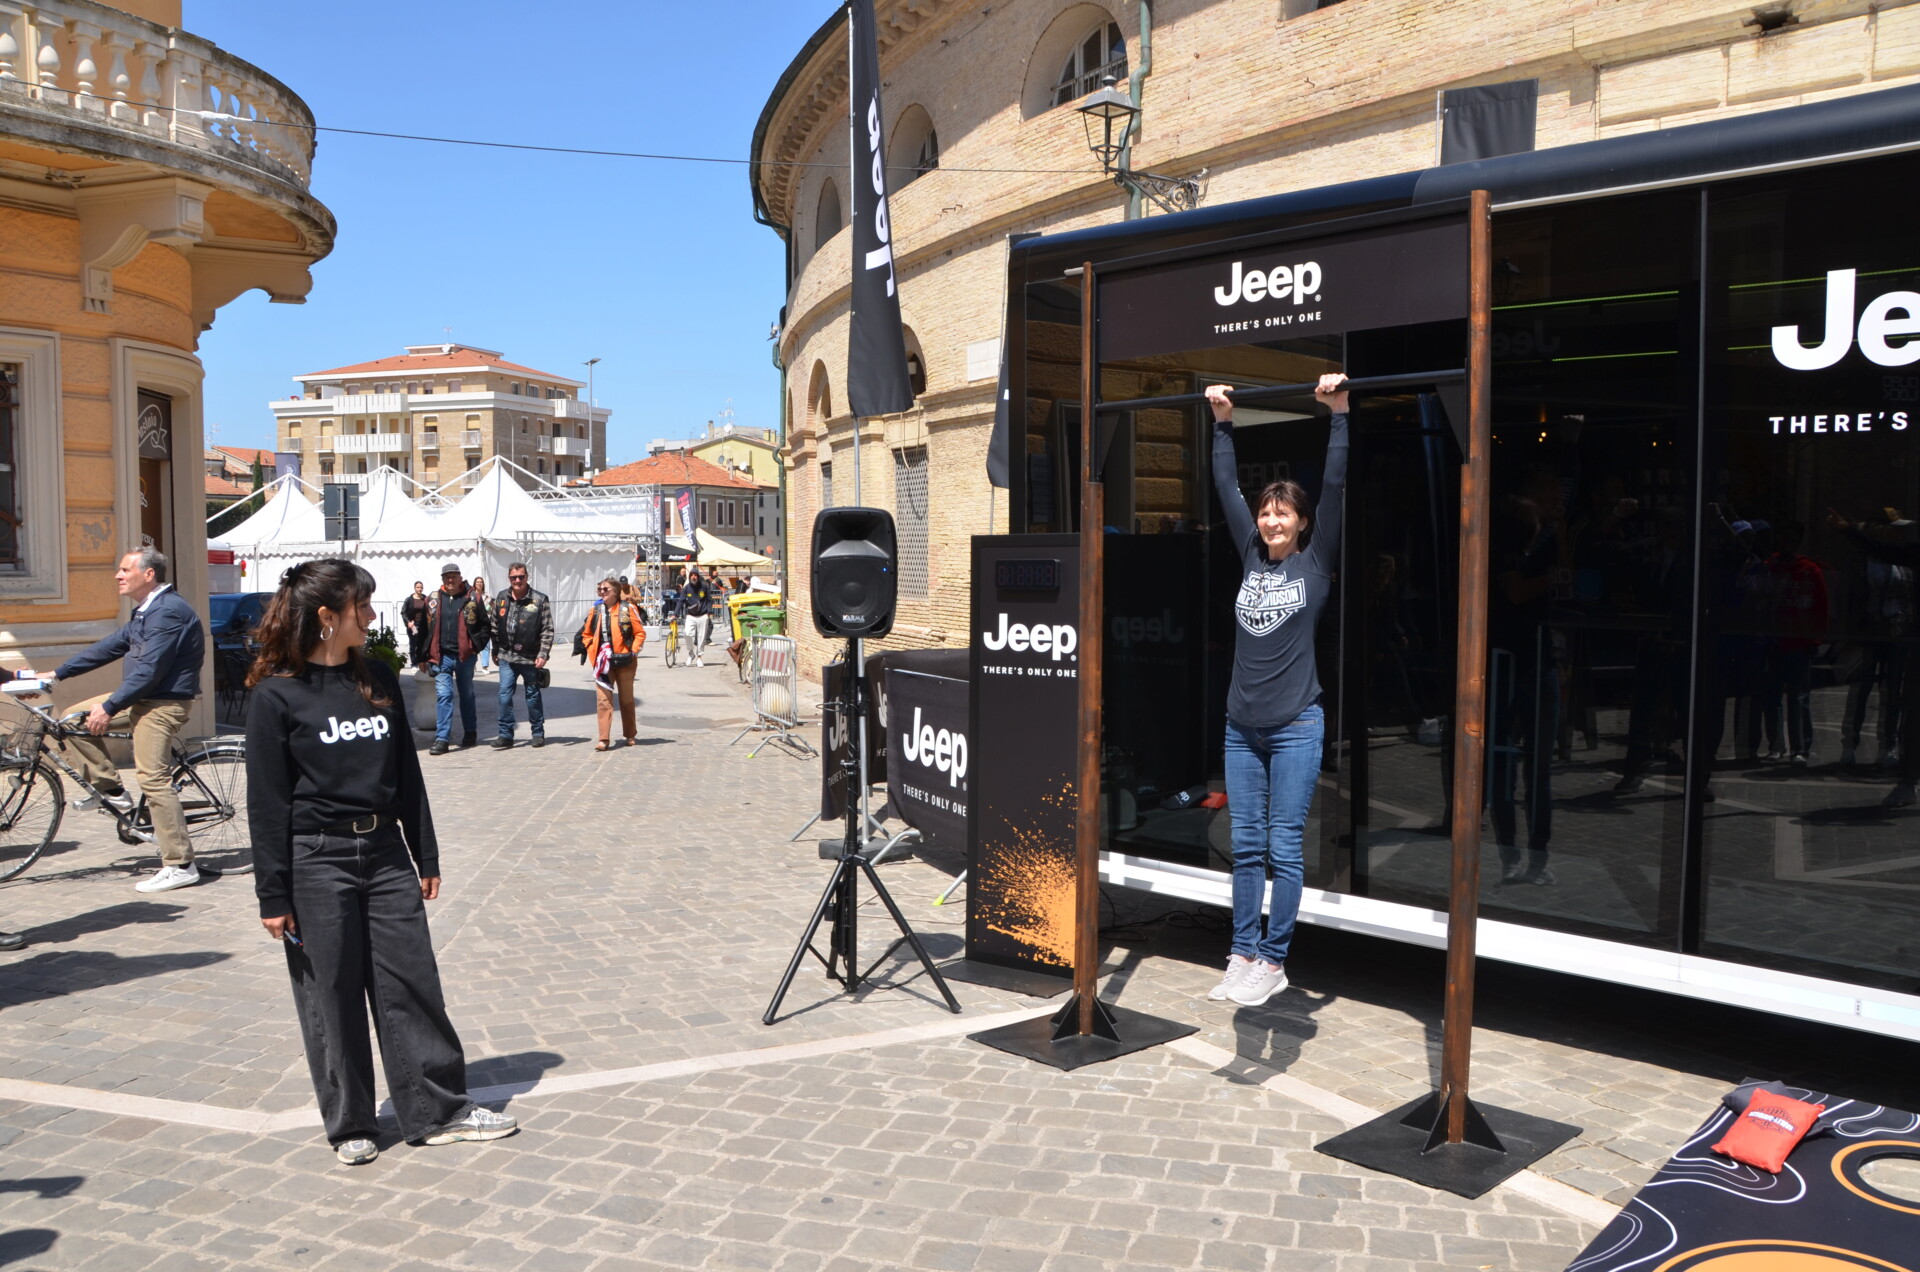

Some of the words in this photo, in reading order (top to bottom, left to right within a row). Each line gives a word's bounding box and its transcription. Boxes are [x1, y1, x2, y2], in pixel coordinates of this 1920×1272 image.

[865, 96, 895, 298] Jeep
[1214, 261, 1322, 306] Jeep
[1214, 320, 1260, 334] THERE'S
[1265, 315, 1293, 327] ONLY
[1298, 311, 1322, 323] ONE
[1768, 411, 1909, 435] THERE'S
[983, 613, 1077, 661] Jeep
[982, 666, 1023, 675] THERE'S
[1027, 668, 1052, 677] ONLY
[1057, 669, 1077, 678] ONE
[319, 714, 389, 744] Jeep
[903, 706, 968, 788] Jeep
[903, 784, 929, 803] THERE'S
[931, 794, 950, 810] ONLY
[952, 803, 967, 817] ONE
